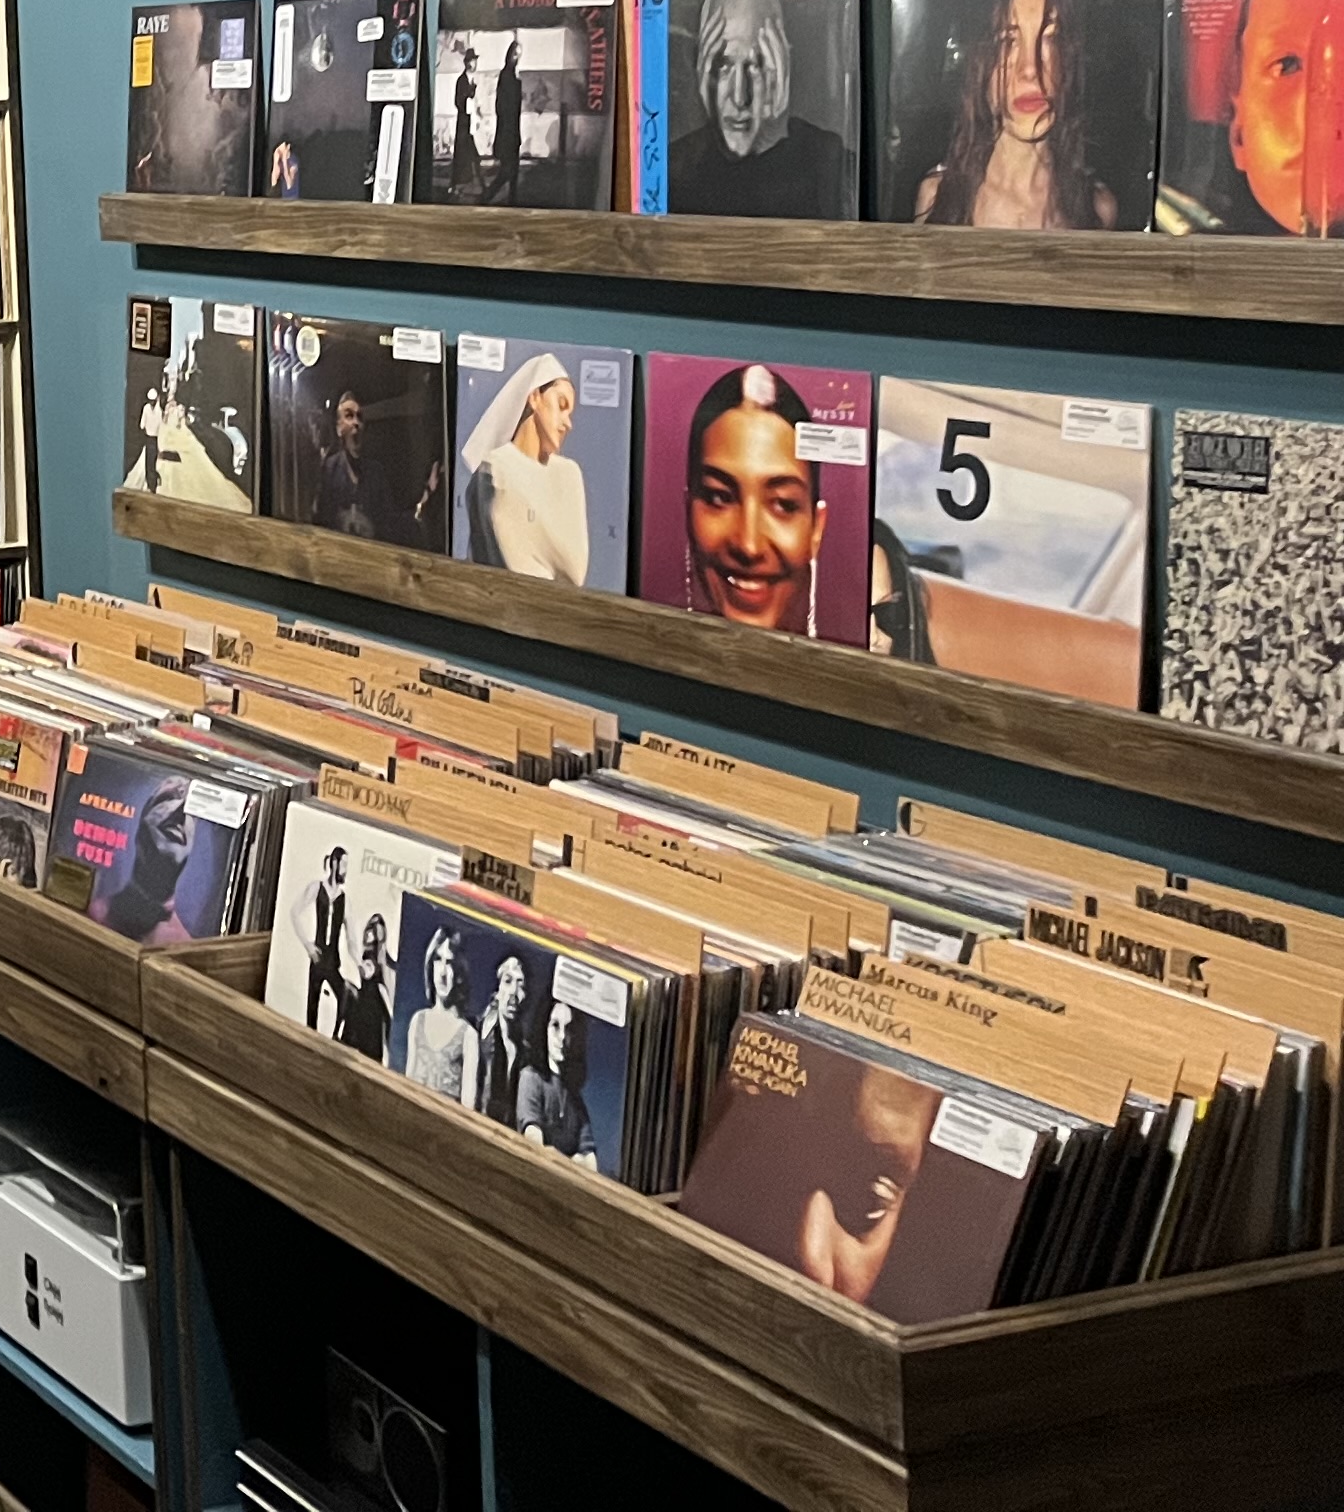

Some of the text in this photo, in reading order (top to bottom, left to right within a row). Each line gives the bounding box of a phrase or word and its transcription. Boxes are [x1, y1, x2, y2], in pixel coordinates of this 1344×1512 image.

[936, 418, 991, 522] 5
[898, 801, 927, 838] G
[1028, 906, 1090, 957] MICHAEL
[1095, 928, 1166, 983] JACKSON
[803, 990, 913, 1046] KIWANUKA
[809, 970, 897, 1016] MICHAEL
[861, 963, 940, 1002] Marcus
[944, 990, 999, 1029] King
[734, 1043, 808, 1087] KIWANUKA
[739, 1026, 799, 1065] MICHAEL
